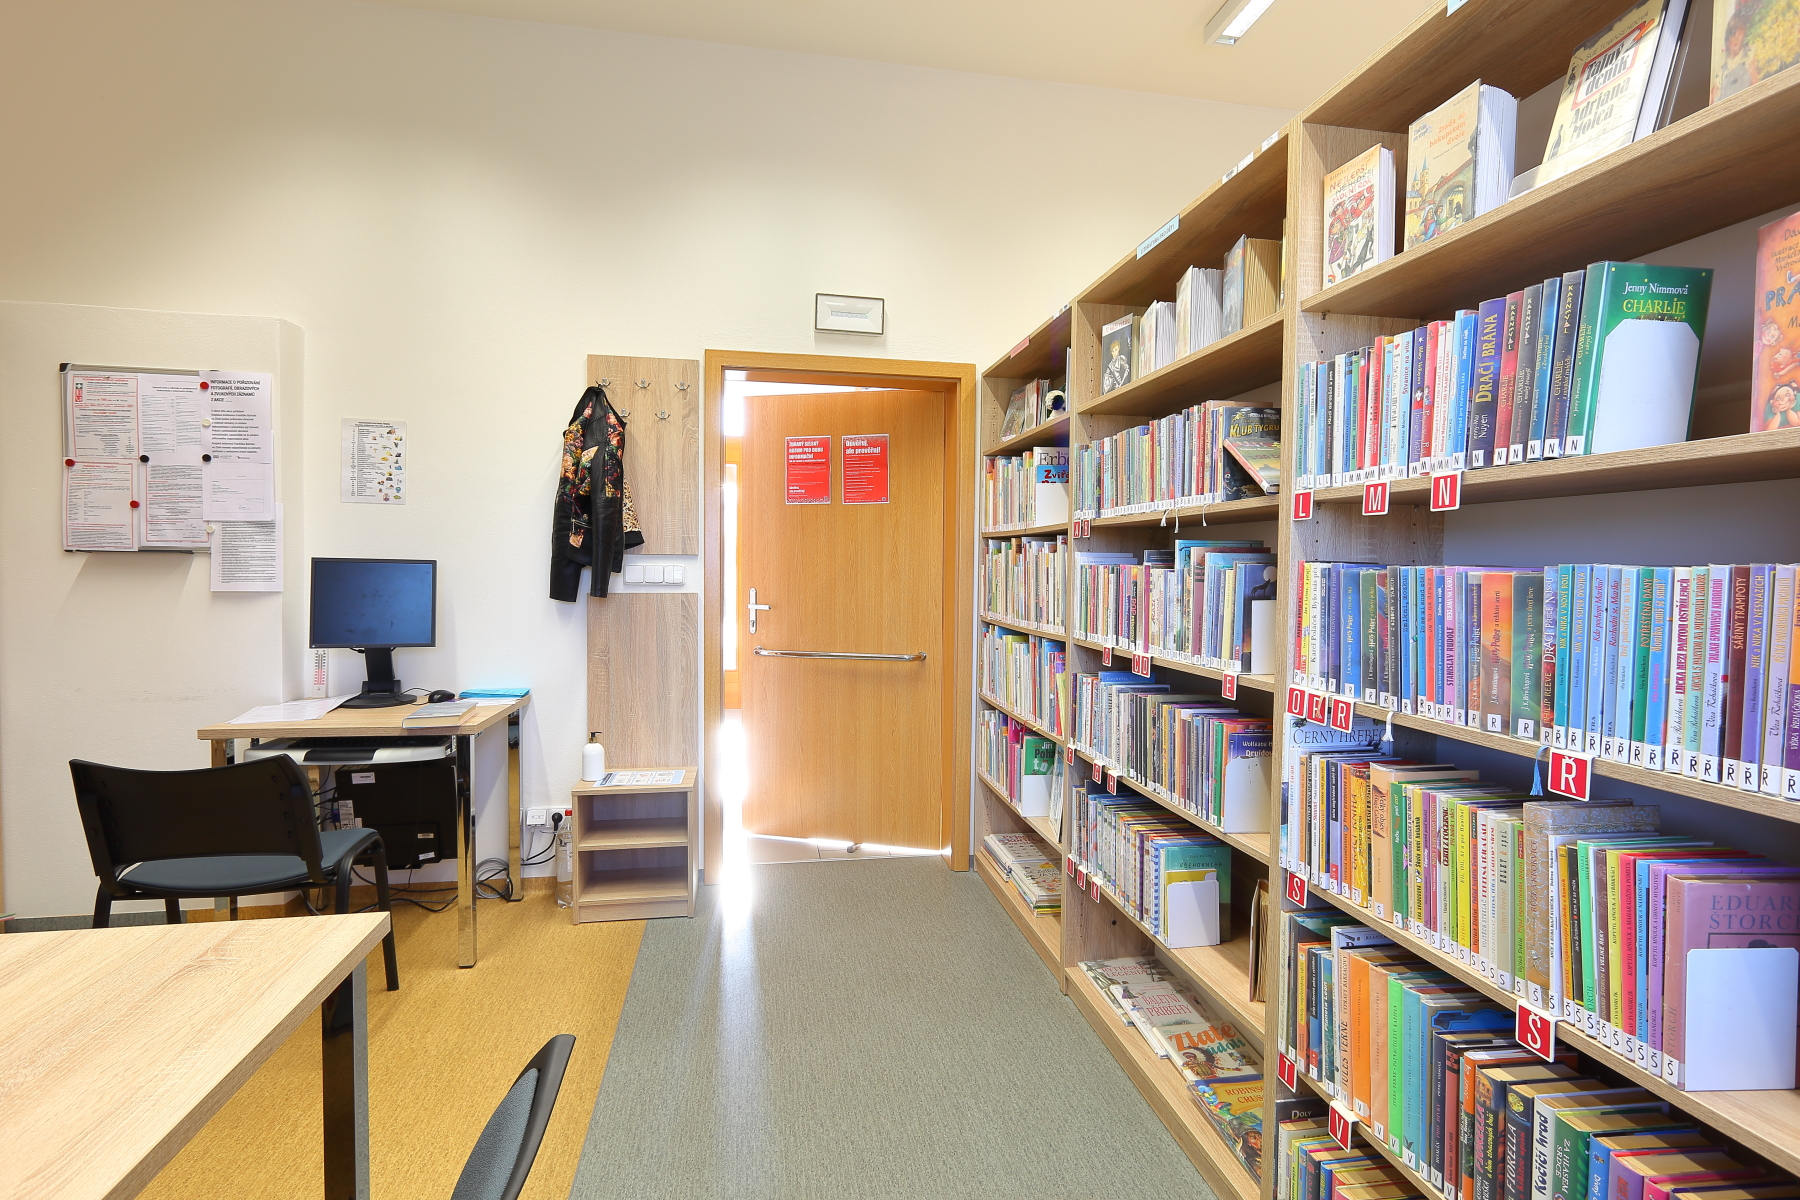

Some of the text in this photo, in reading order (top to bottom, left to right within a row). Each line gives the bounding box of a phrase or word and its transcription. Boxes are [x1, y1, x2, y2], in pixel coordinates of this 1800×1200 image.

[1569, 76, 1631, 128] Adriana
[1623, 282, 1689, 295] Jenny Nimmová
[1623, 297, 1686, 315] CHARLIE
[1475, 313, 1498, 403] DRAČÍ BRÁNA
[1230, 423, 1253, 437] KLUB
[1571, 439, 1579, 451] N
[1368, 486, 1383, 512] M
[1439, 478, 1451, 506] N
[1299, 495, 1306, 517] L
[1622, 578, 1631, 593] krku
[1692, 573, 1707, 597] TÁBOŘE
[1752, 575, 1765, 618] NESNÁZÍCH
[1559, 574, 1569, 648] NIK NIKA NOVÉ ROLI
[1574, 572, 1586, 652] NIK NIKA SUPER DVOJKA
[1708, 578, 1724, 664] TROJKA SPRÁVNÝCH KAMARÁDŮ
[1732, 577, 1747, 650] SÁŘINY TRAMPOTY
[1639, 600, 1652, 648] POTŘEŠTĚNÁ
[1592, 628, 1601, 641] Kdo
[1675, 578, 1690, 694] LUCKA MEZI PARTOU OSTŘÍLENCŮ
[1751, 627, 1762, 647] NIKA
[1446, 626, 1454, 687] STANISLAV RUDOLF
[1620, 644, 1628, 657] Dvě
[1773, 644, 1785, 663] PĚTKA
[1750, 654, 1760, 668] NIK
[1226, 677, 1232, 696] E
[1292, 690, 1301, 714] O
[1542, 672, 1552, 724] PHILIP REEVE
[1337, 702, 1347, 728] R
[1492, 718, 1497, 728] R
[1524, 723, 1530, 734] R
[1590, 736, 1596, 750] Ř
[1790, 731, 1799, 750] VĚRA
[1634, 745, 1640, 762] Ř
[1649, 749, 1656, 766] Ř
[1672, 748, 1679, 765] Ř
[1690, 755, 1697, 773] Ř
[1704, 759, 1712, 777] Ř
[1727, 763, 1735, 782] Ř
[1561, 755, 1578, 794] Ř
[1745, 767, 1752, 786] Ř
[1788, 774, 1796, 794] Ř
[1293, 877, 1301, 900] S
[1711, 895, 1800, 911] EDUAR
[1141, 993, 1181, 1005] BALETNÍ
[1146, 1003, 1193, 1017] PŘÍBĚHY
[1168, 1022, 1237, 1052] Zlaté
[1527, 1013, 1541, 1050] Š
[1340, 1020, 1349, 1088] JULES VERNE
[1626, 1036, 1633, 1053] Š
[1638, 1043, 1645, 1061] Š
[1650, 1050, 1658, 1068] Š
[1667, 1057, 1675, 1076] Š
[1283, 1057, 1291, 1082] T
[1291, 1110, 1312, 1120] DOLY
[1335, 1113, 1344, 1140] V
[1475, 1103, 1485, 1174] FIORELLA
[1506, 1122, 1517, 1194] FIORELLA
[1534, 1110, 1548, 1196] Kočičí hrad
[1555, 1144, 1563, 1178] SRDCE
[1562, 1138, 1571, 1194] ZA HLASEM
